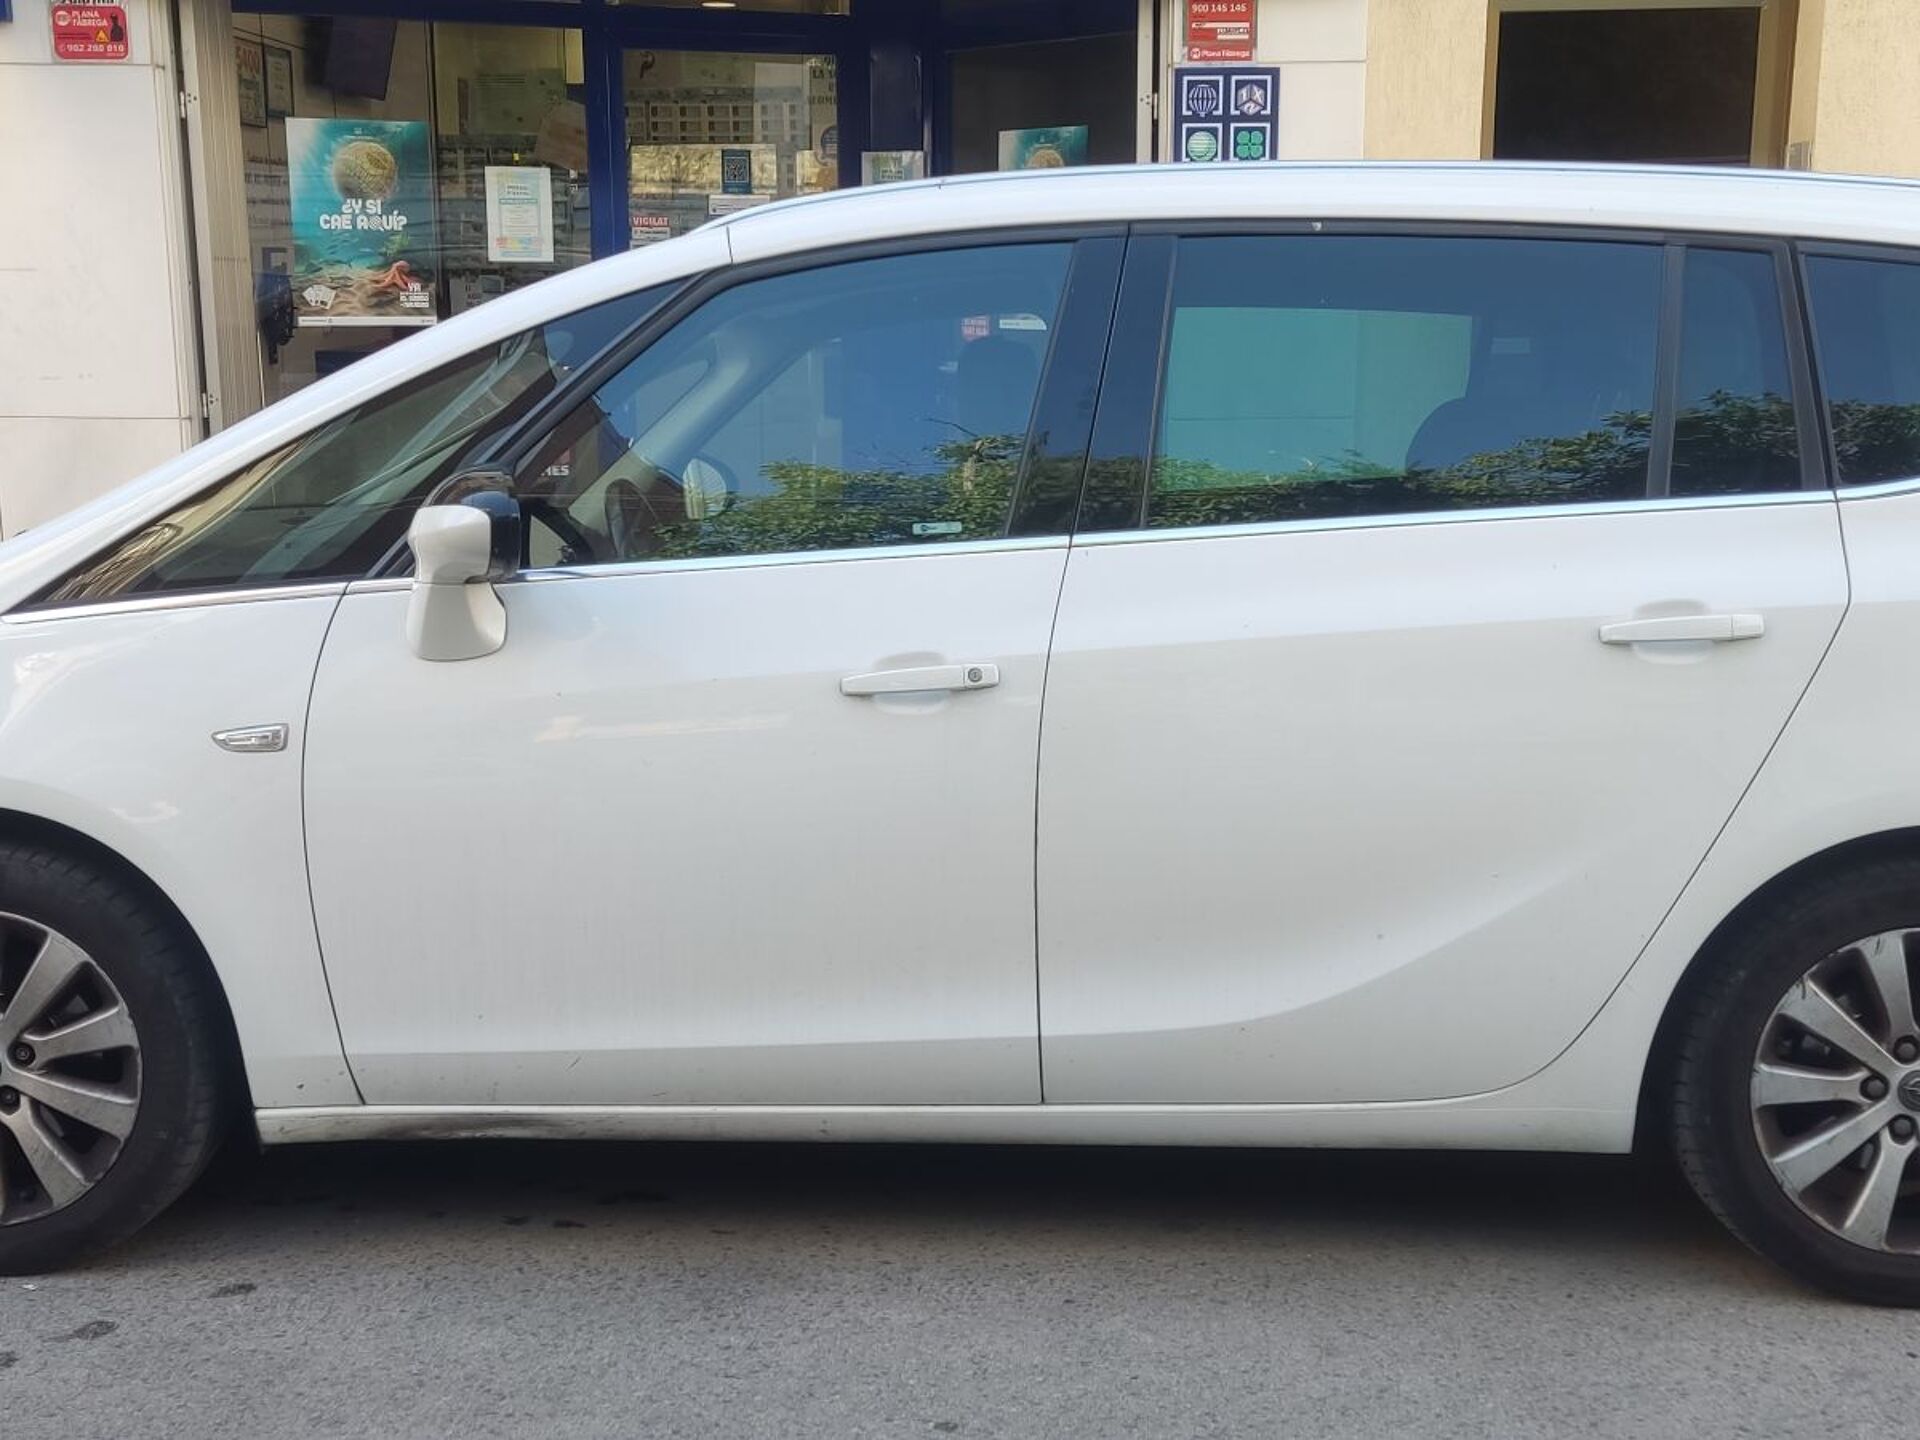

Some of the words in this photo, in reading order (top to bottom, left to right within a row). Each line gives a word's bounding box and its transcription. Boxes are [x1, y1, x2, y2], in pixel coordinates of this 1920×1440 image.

[1192, 4, 1209, 13] 900
[1211, 4, 1228, 12] 145
[1230, 3, 1247, 12] 145
[365, 198, 382, 215] SI
[319, 214, 353, 230] CAE
[356, 209, 408, 231] AQUÍ?
